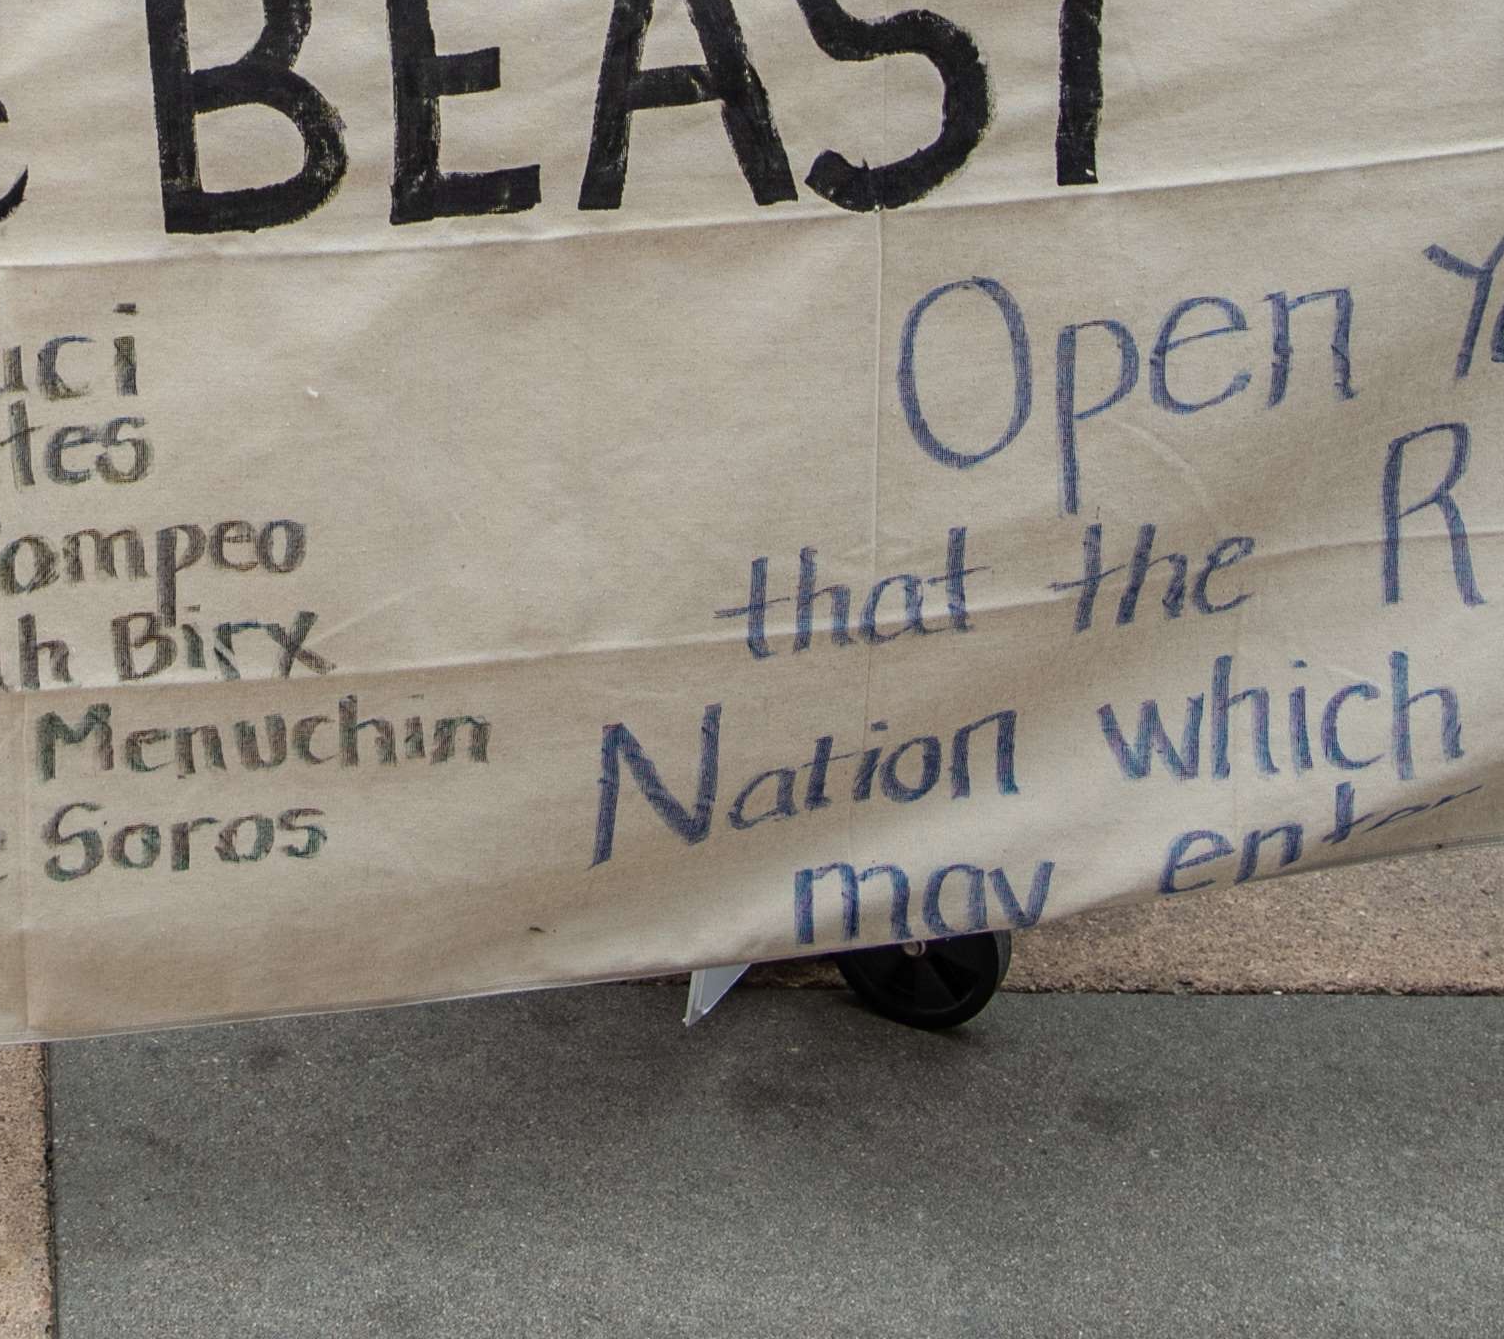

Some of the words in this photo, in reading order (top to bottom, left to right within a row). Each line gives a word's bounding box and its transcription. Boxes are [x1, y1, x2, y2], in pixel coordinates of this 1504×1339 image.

[896, 276, 1360, 518] Open
[714, 526, 992, 659] that
[1048, 507, 1257, 633] the
[111, 606, 336, 682] Birx
[35, 694, 494, 782] Menuchin
[589, 703, 1020, 870] Nation
[1097, 651, 1465, 782] which
[41, 801, 328, 882] Soros
